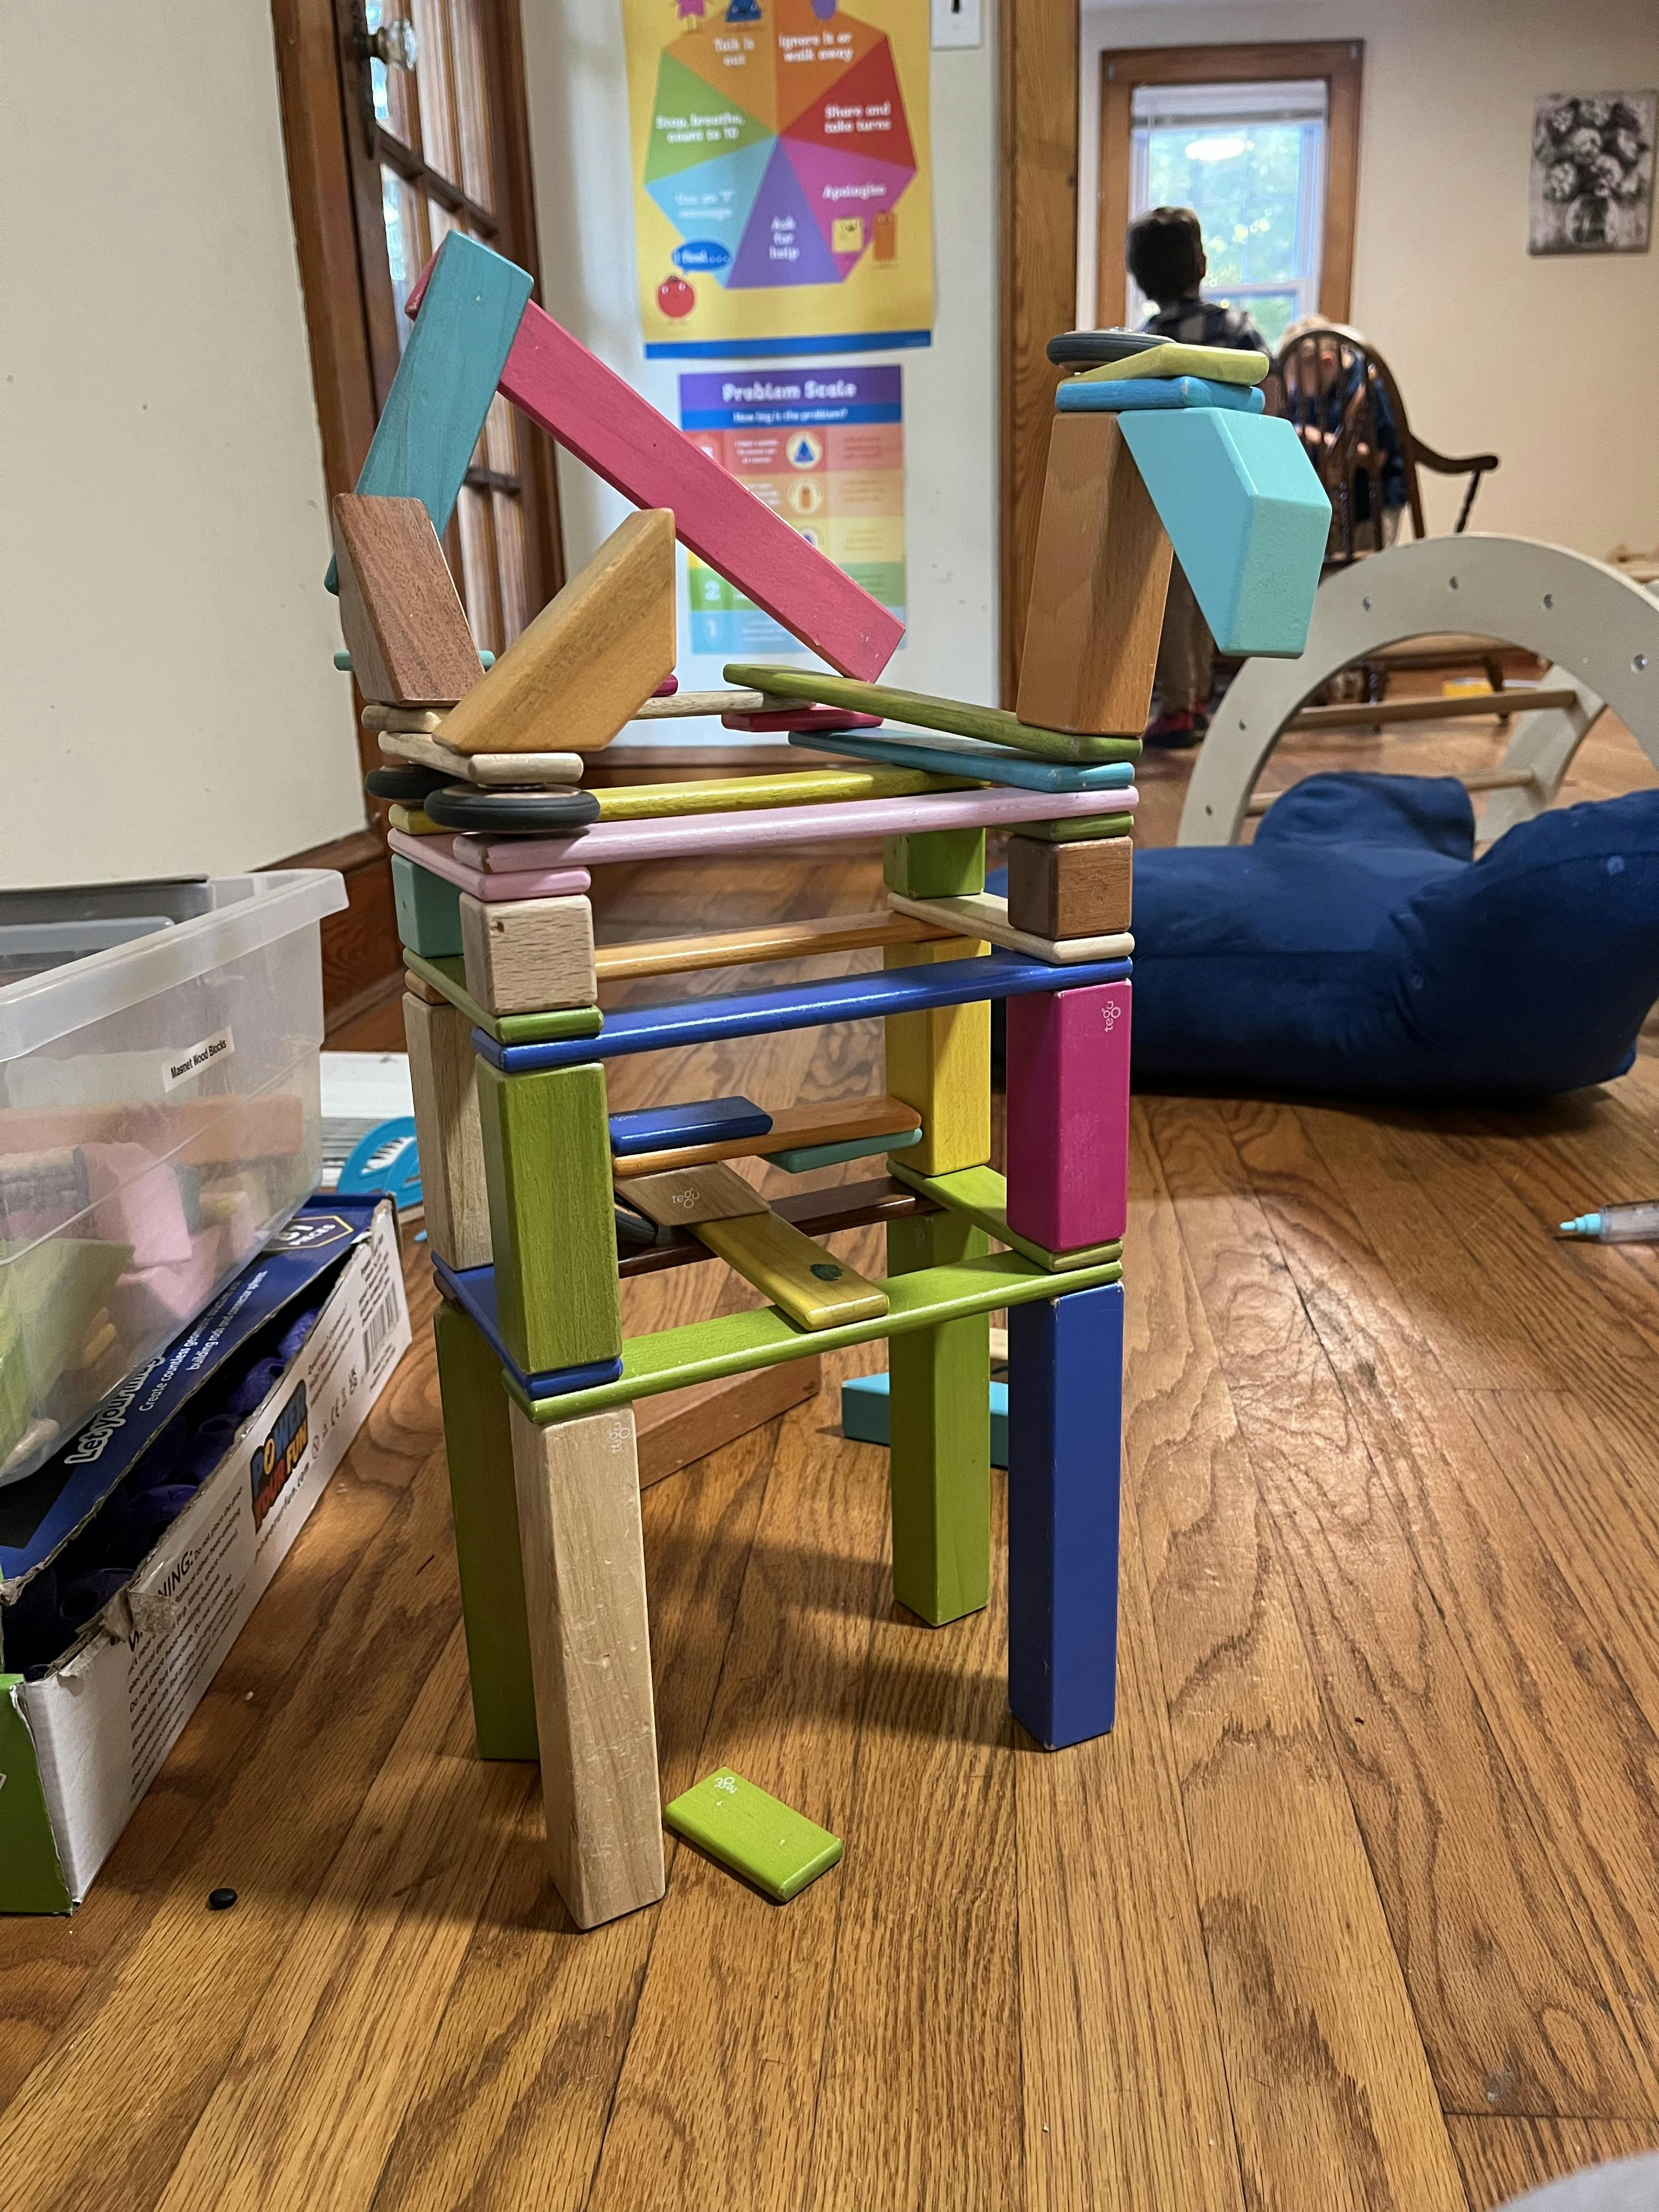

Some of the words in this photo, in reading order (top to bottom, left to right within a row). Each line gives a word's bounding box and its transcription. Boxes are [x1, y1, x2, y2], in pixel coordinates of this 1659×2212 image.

[778, 36, 820, 51] Ignore
[818, 49, 854, 62] away
[825, 104, 863, 119] Share
[865, 100, 891, 116] and
[769, 246, 800, 262] help
[722, 381, 801, 403] Problem
[804, 379, 857, 399] Scale
[733, 412, 754, 424] How
[704, 580, 720, 601] 2
[171, 1058, 193, 1079] Magnet
[193, 1048, 208, 1066] Wood
[208, 1040, 227, 1057] Blocks
[672, 1187, 699, 1209] tegu
[186, 1341, 219, 1370] building
[139, 1382, 167, 1412] Create
[161, 1347, 191, 1382] countless
[67, 1430, 110, 1463] Let
[94, 1393, 128, 1428] your
[252, 1381, 307, 1500] POWER
[254, 1458, 285, 1533] YOUR
[286, 1421, 308, 1474] FUN
